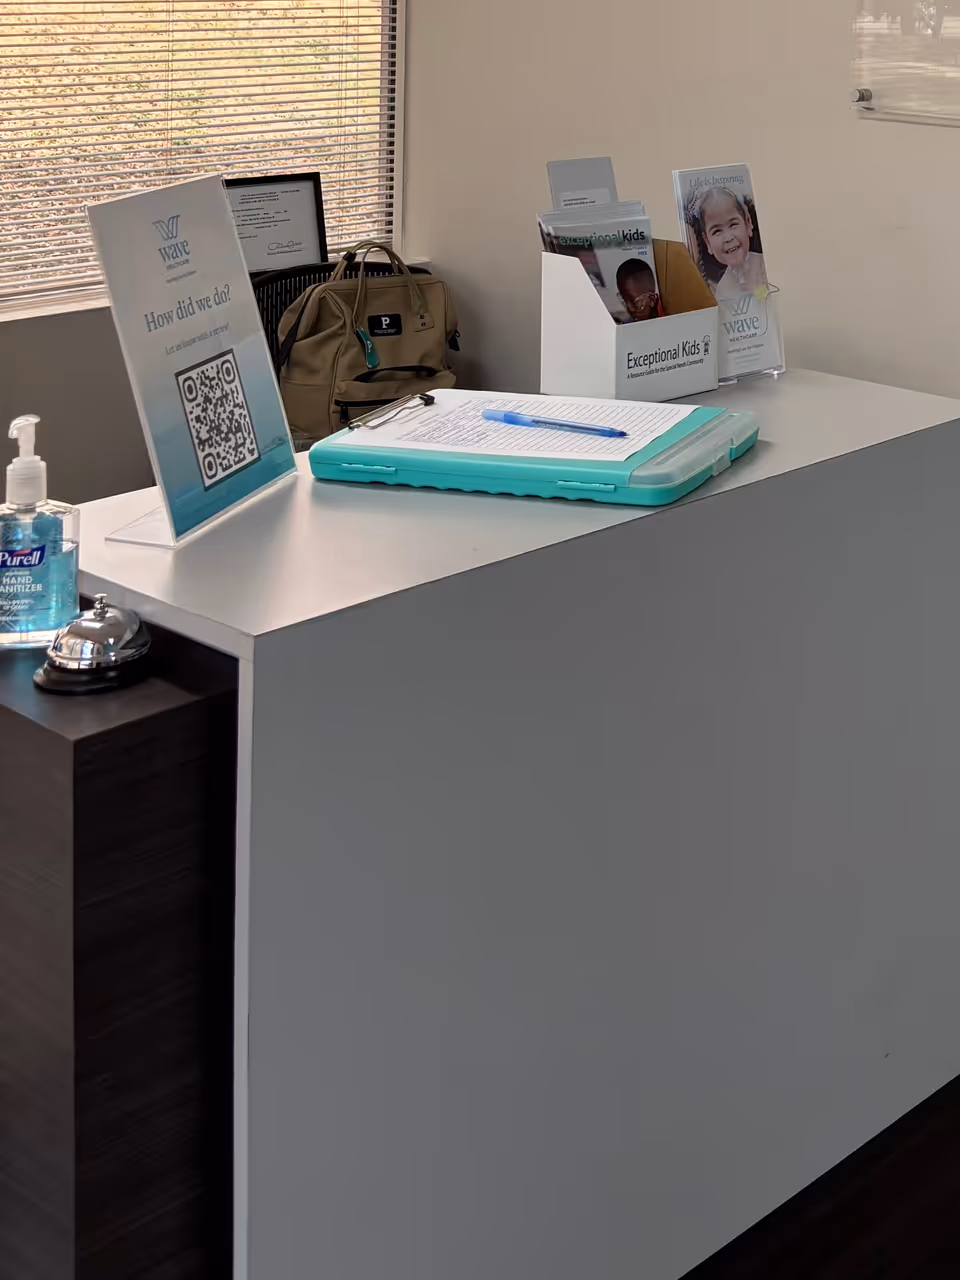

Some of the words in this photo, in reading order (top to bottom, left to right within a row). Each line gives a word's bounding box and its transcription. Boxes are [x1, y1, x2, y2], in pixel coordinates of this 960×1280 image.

[158, 240, 191, 263] wave
[144, 309, 175, 332] How
[176, 296, 196, 321] did
[196, 295, 213, 312] we
[213, 284, 232, 307] do?
[381, 317, 390, 329] P
[723, 316, 760, 335] wave
[627, 343, 680, 370] Exceptional
[681, 339, 701, 358] Kids
[0, 550, 41, 566] Purell
[0, 583, 42, 593] ANITIZER
[3, 576, 33, 585] HAND
